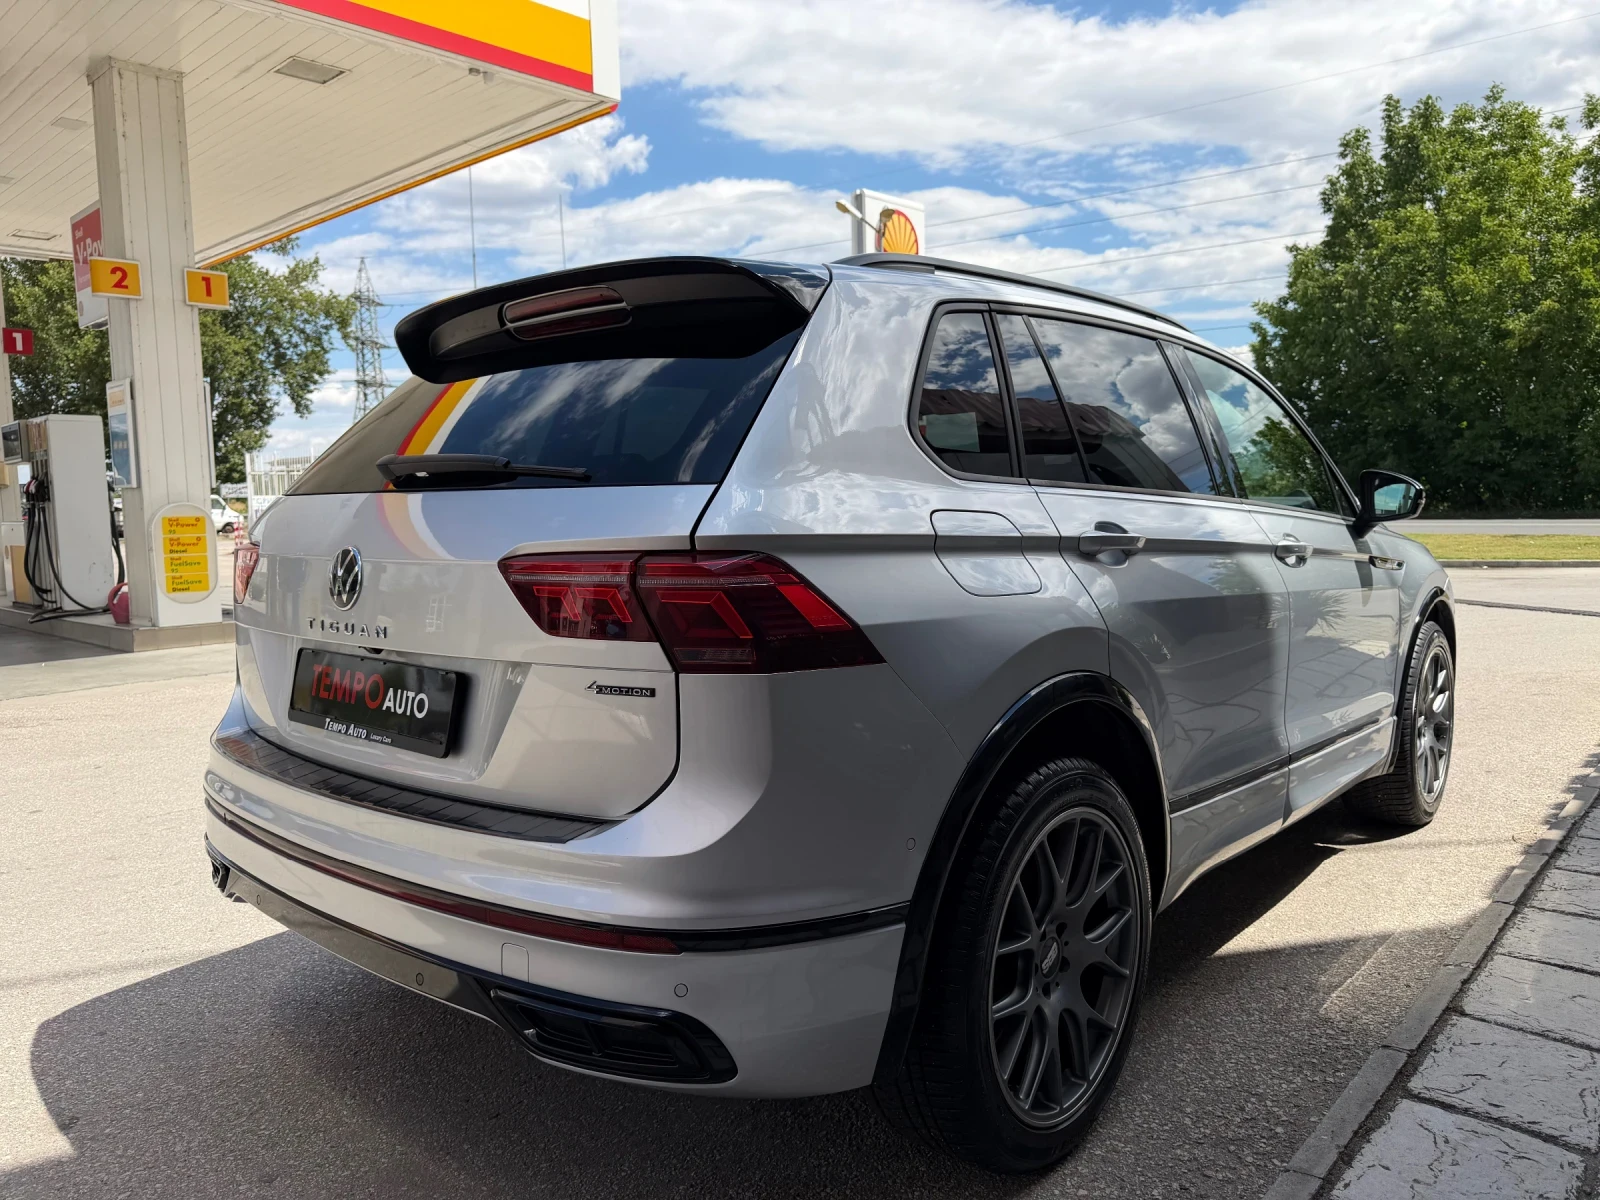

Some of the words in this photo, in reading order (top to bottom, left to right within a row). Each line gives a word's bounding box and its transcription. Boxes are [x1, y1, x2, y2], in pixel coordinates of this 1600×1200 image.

[110, 266, 129, 290] 2
[201, 276, 212, 297] 1
[12, 332, 23, 351] 1
[306, 616, 389, 639] TIGUAN
[311, 663, 384, 709] TEMPO
[382, 687, 429, 719] AUTO
[585, 680, 652, 697] 4MOTION
[324, 717, 347, 734] TEMPO
[347, 723, 367, 739] AUTO
